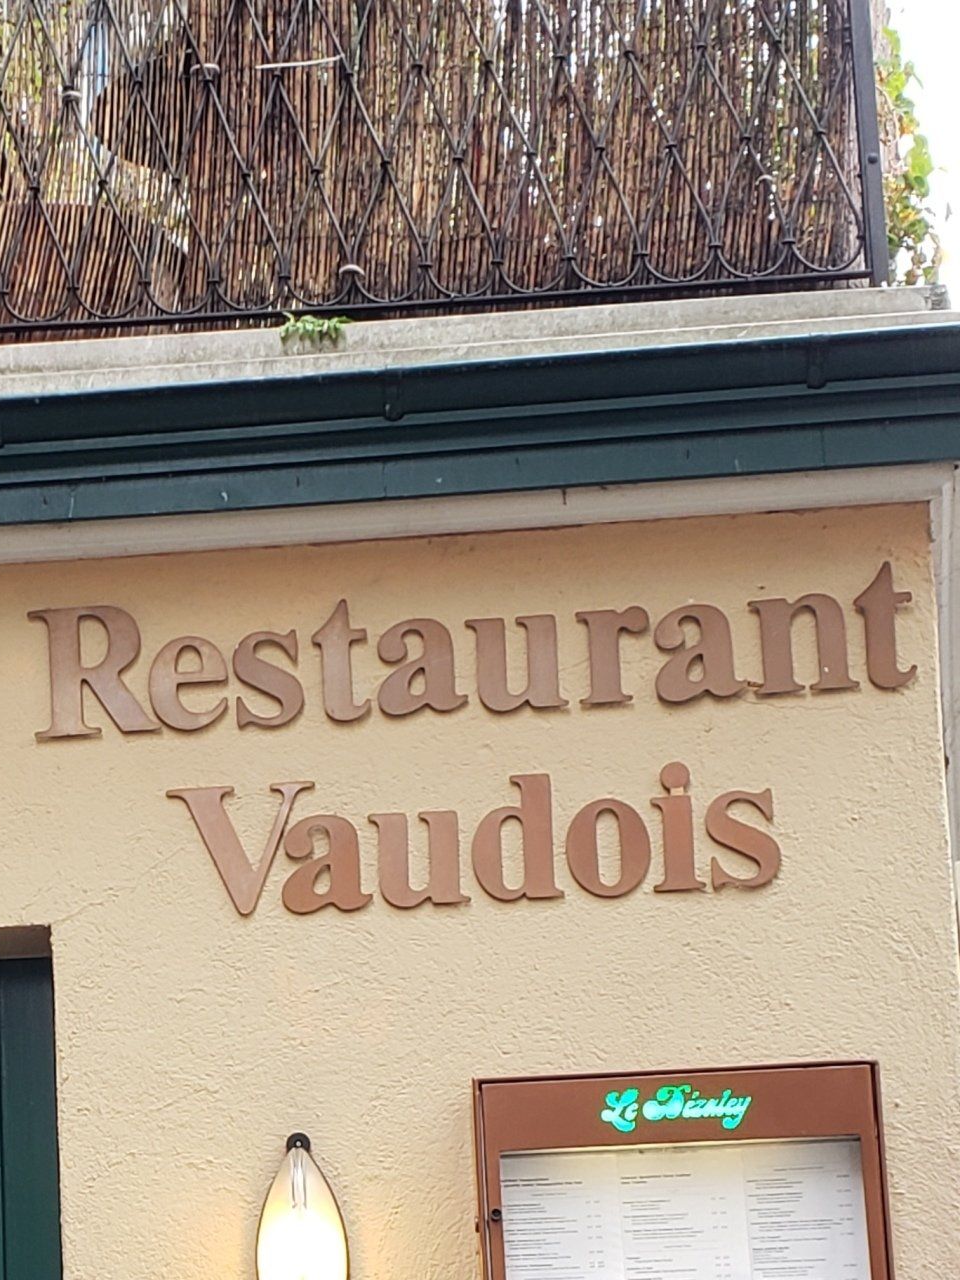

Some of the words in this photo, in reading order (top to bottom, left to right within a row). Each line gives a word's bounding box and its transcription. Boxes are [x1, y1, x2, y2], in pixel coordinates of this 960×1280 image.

[27, 561, 918, 741] Restaurant
[166, 762, 782, 916] Vaudois
[601, 1087, 639, 1132] Le
[642, 1084, 752, 1130] Dézaley
